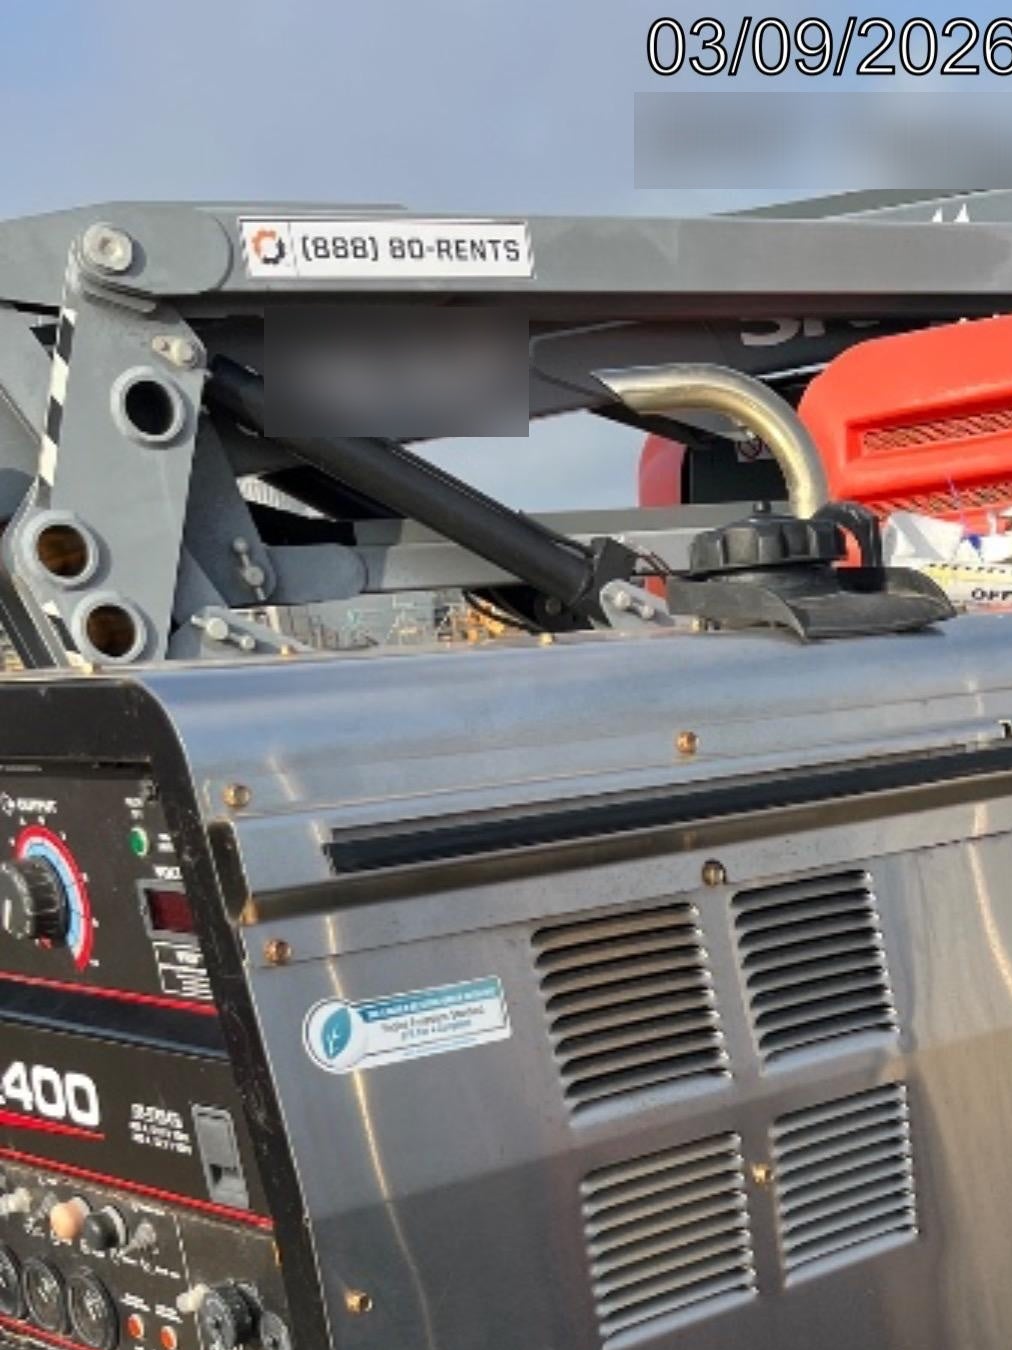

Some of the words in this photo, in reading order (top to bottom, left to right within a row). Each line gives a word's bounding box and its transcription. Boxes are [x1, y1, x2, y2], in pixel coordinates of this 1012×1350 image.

[301, 236, 379, 261] (888)
[389, 238, 520, 262] 80-RENTS
[0, 1060, 100, 1126] 400
